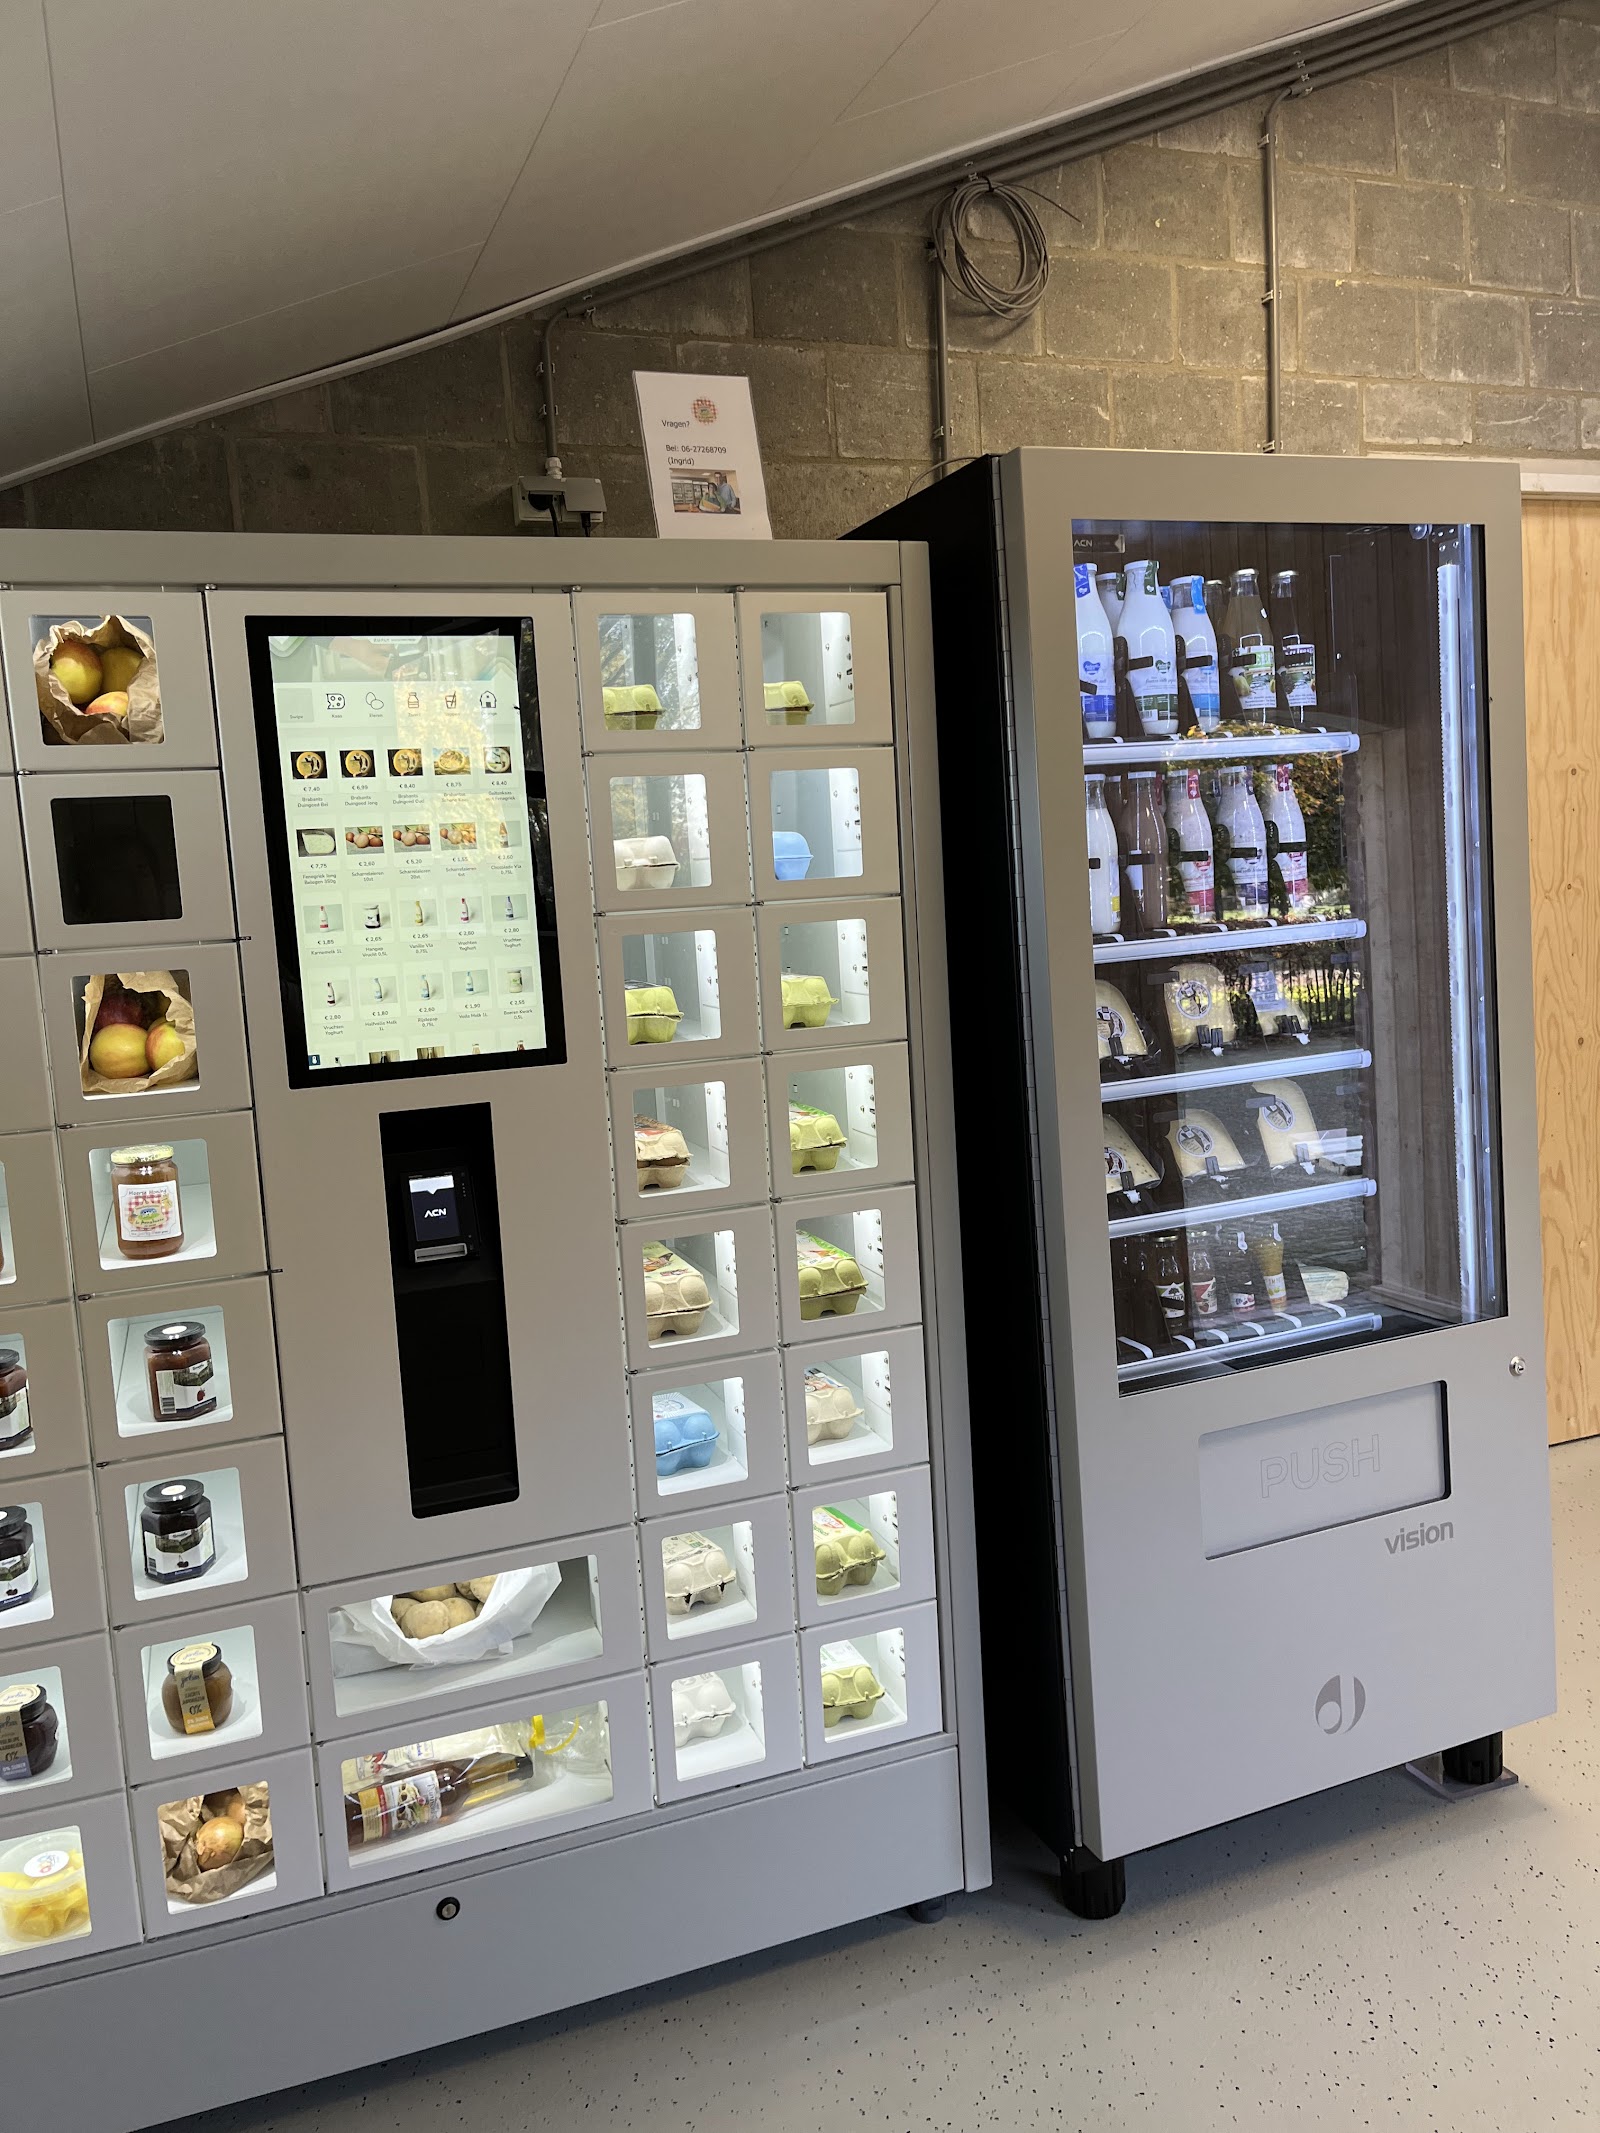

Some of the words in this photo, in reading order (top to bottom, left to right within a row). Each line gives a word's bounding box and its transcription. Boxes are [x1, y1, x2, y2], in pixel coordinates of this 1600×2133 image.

[661, 420, 690, 428] Vragen?
[681, 445, 727, 454] 06-27268709
[667, 457, 695, 466] (Ingrid)
[1073, 539, 1093, 547] ACN
[424, 1207, 447, 1218] ACN
[1260, 1433, 1380, 1498] PUSH
[1384, 1521, 1454, 1555] vision
[5, 1751, 19, 1762] 0%
